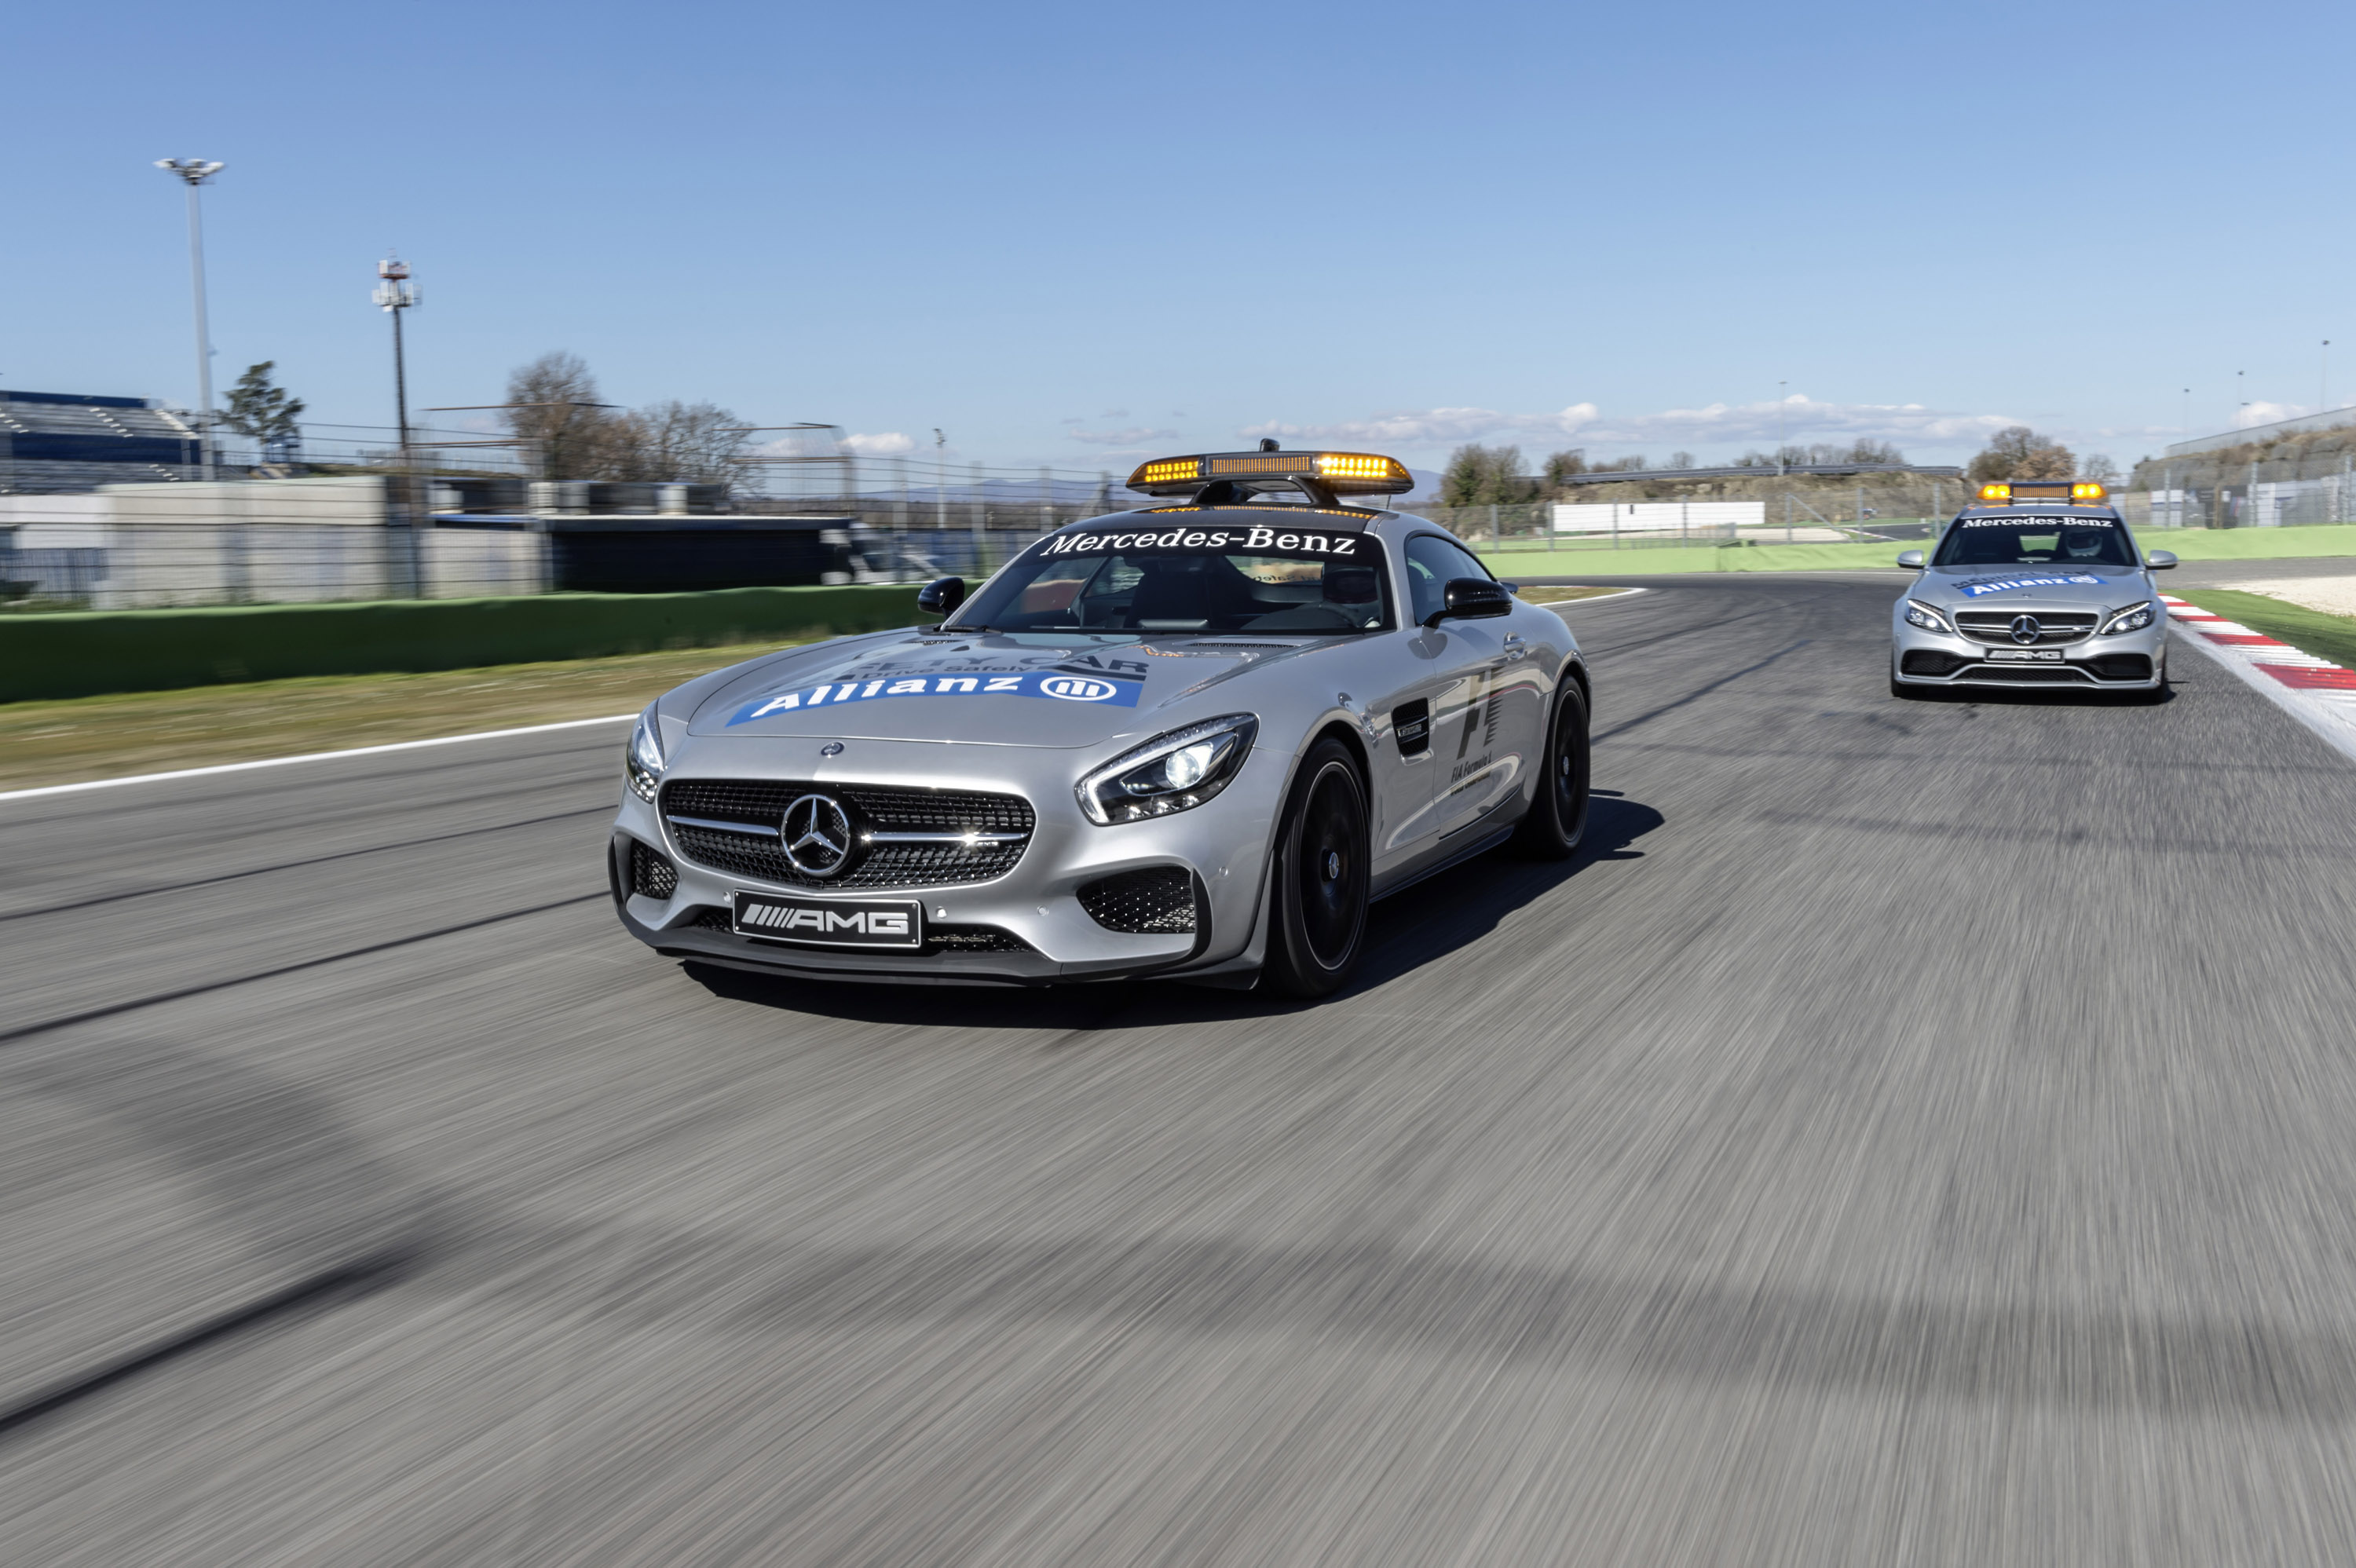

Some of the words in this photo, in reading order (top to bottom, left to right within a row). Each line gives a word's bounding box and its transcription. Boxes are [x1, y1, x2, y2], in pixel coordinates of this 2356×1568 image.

[1961, 517, 2113, 528] Mercedes-Benz
[1039, 528, 1357, 557] Mercedes-Benz
[1972, 577, 2069, 595] Allianz
[862, 667, 934, 679] Drive
[1020, 655, 1149, 674] CAR
[750, 675, 1023, 718] Allianz
[1451, 763, 1463, 783] FIA
[785, 907, 909, 934] AMG
